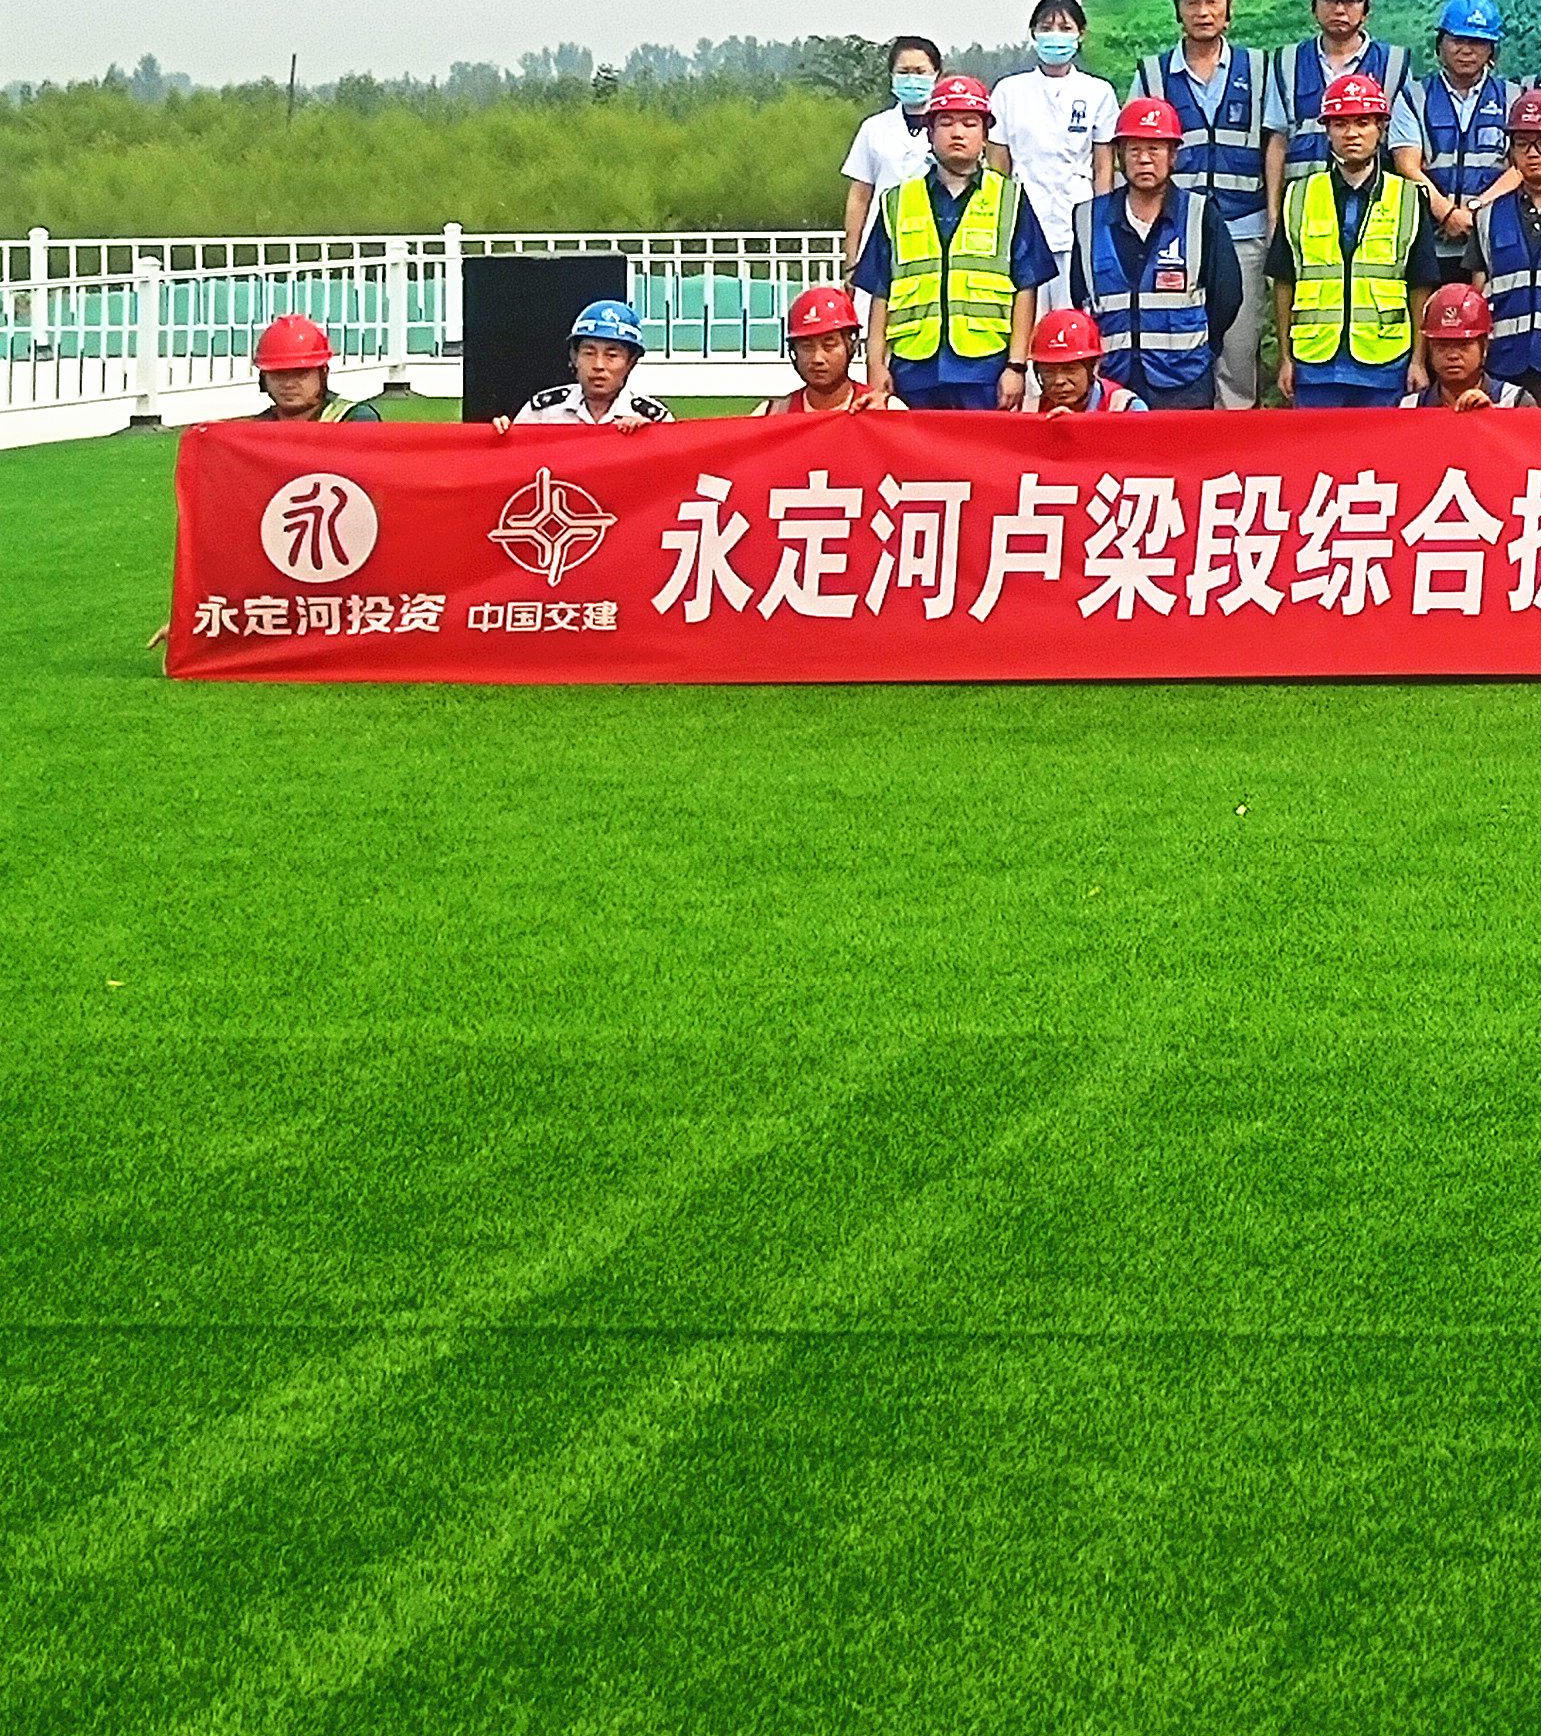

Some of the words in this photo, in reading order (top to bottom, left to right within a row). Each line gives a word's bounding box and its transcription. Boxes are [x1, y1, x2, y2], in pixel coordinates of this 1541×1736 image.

[193, 593, 446, 638] 永定河投资
[467, 600, 618, 633] 中国交建
